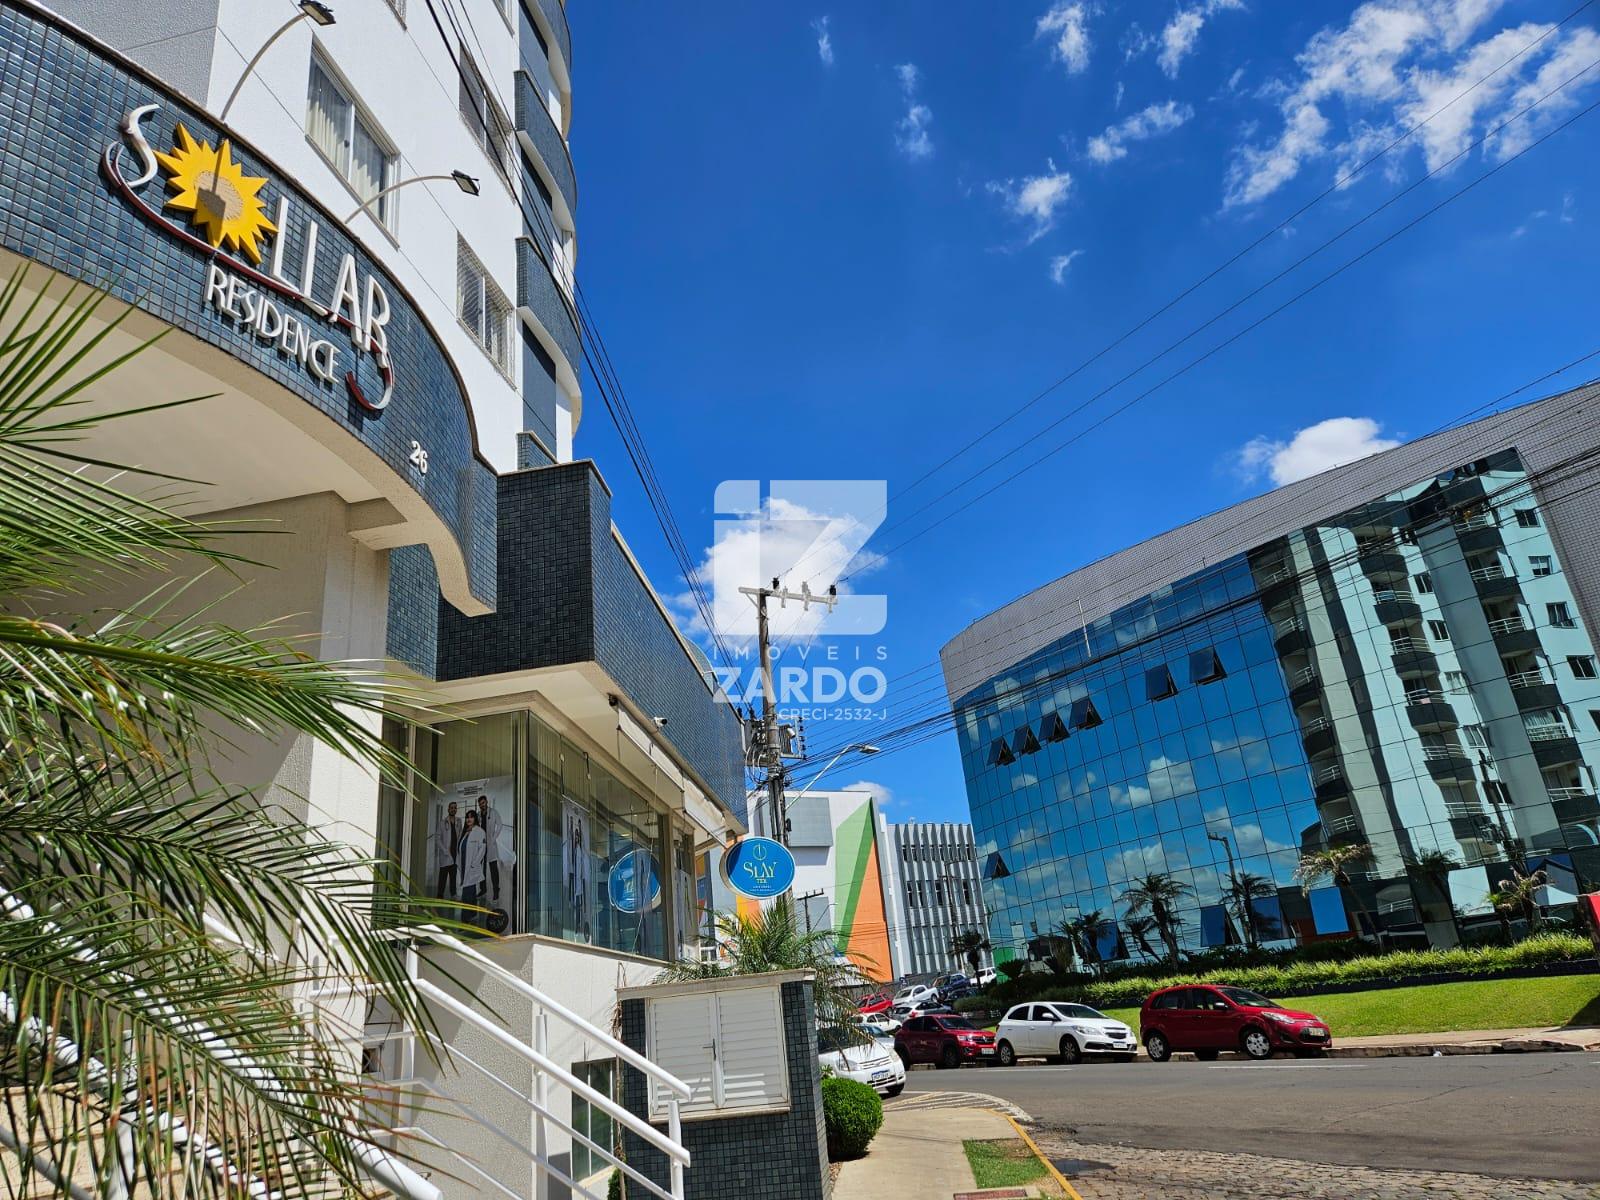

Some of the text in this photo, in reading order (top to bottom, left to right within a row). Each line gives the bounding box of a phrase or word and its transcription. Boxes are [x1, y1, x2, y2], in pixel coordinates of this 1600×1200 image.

[206, 261, 341, 384] RESIDENCE
[410, 440, 428, 474] 26
[743, 861, 778, 878] SLAY
